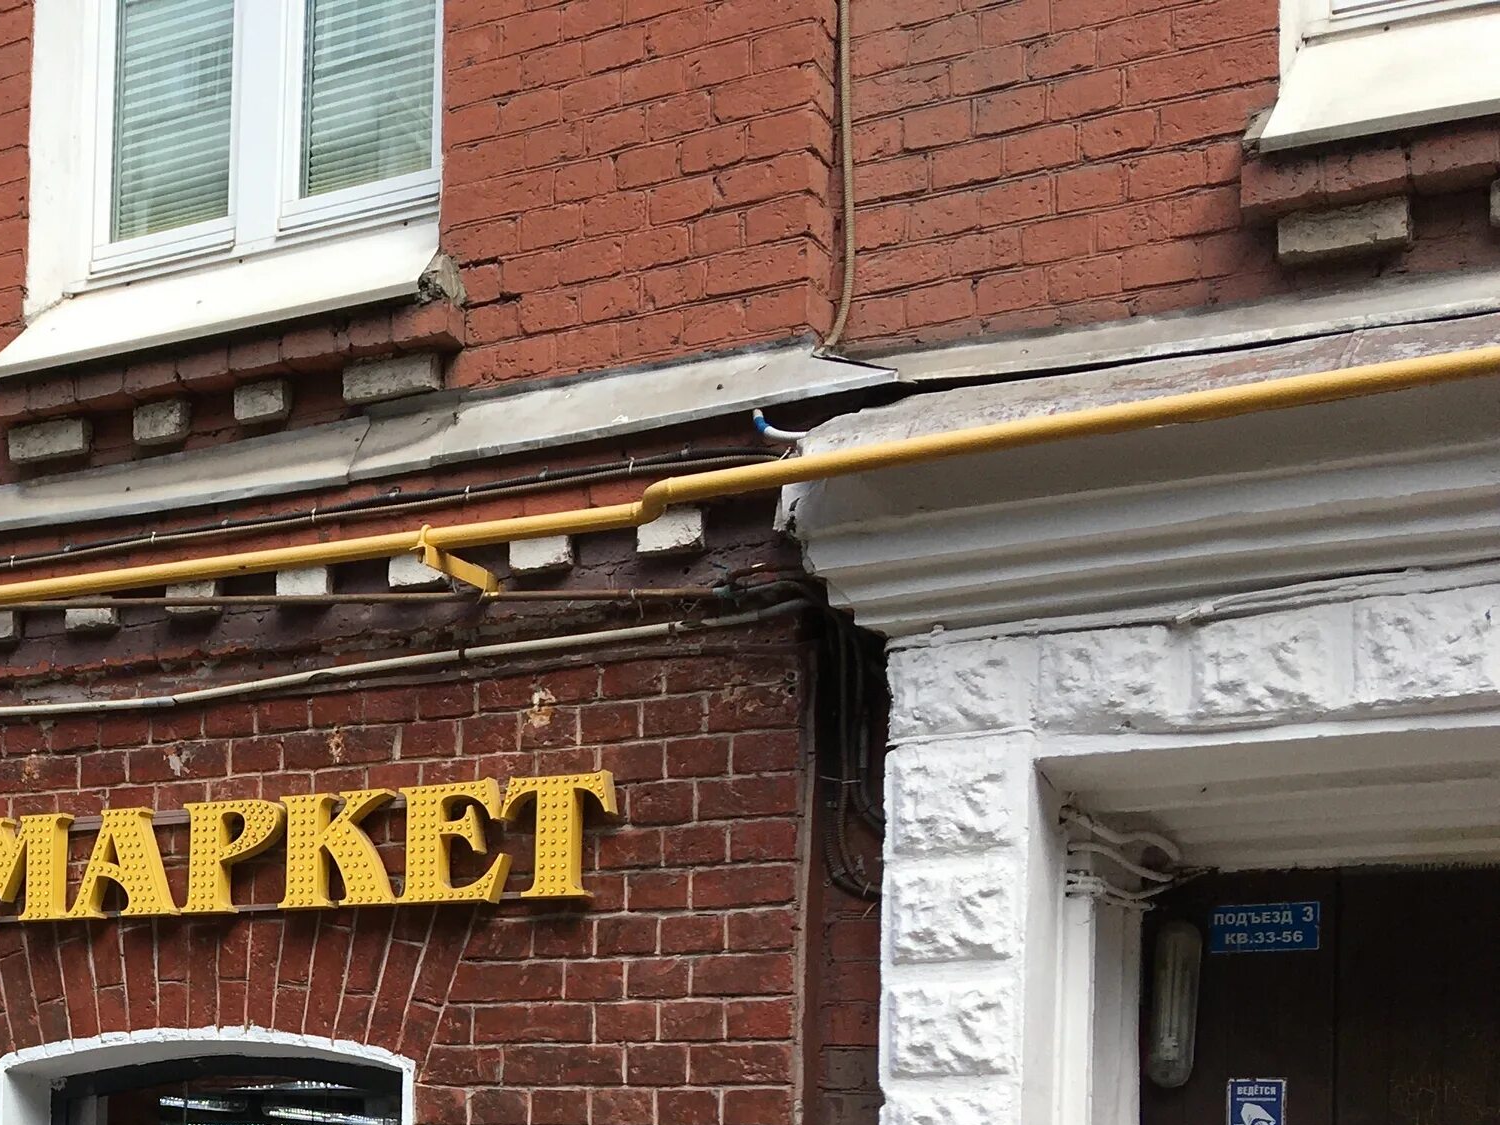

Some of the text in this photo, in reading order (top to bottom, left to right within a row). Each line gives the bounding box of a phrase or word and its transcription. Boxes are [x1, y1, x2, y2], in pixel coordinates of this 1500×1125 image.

[1213, 905, 1314, 927] ПОДЪЕЗД 3
[1224, 930, 1304, 944] КВ.33-56
[1236, 1085, 1276, 1096] ВЕДЁТСЯ
